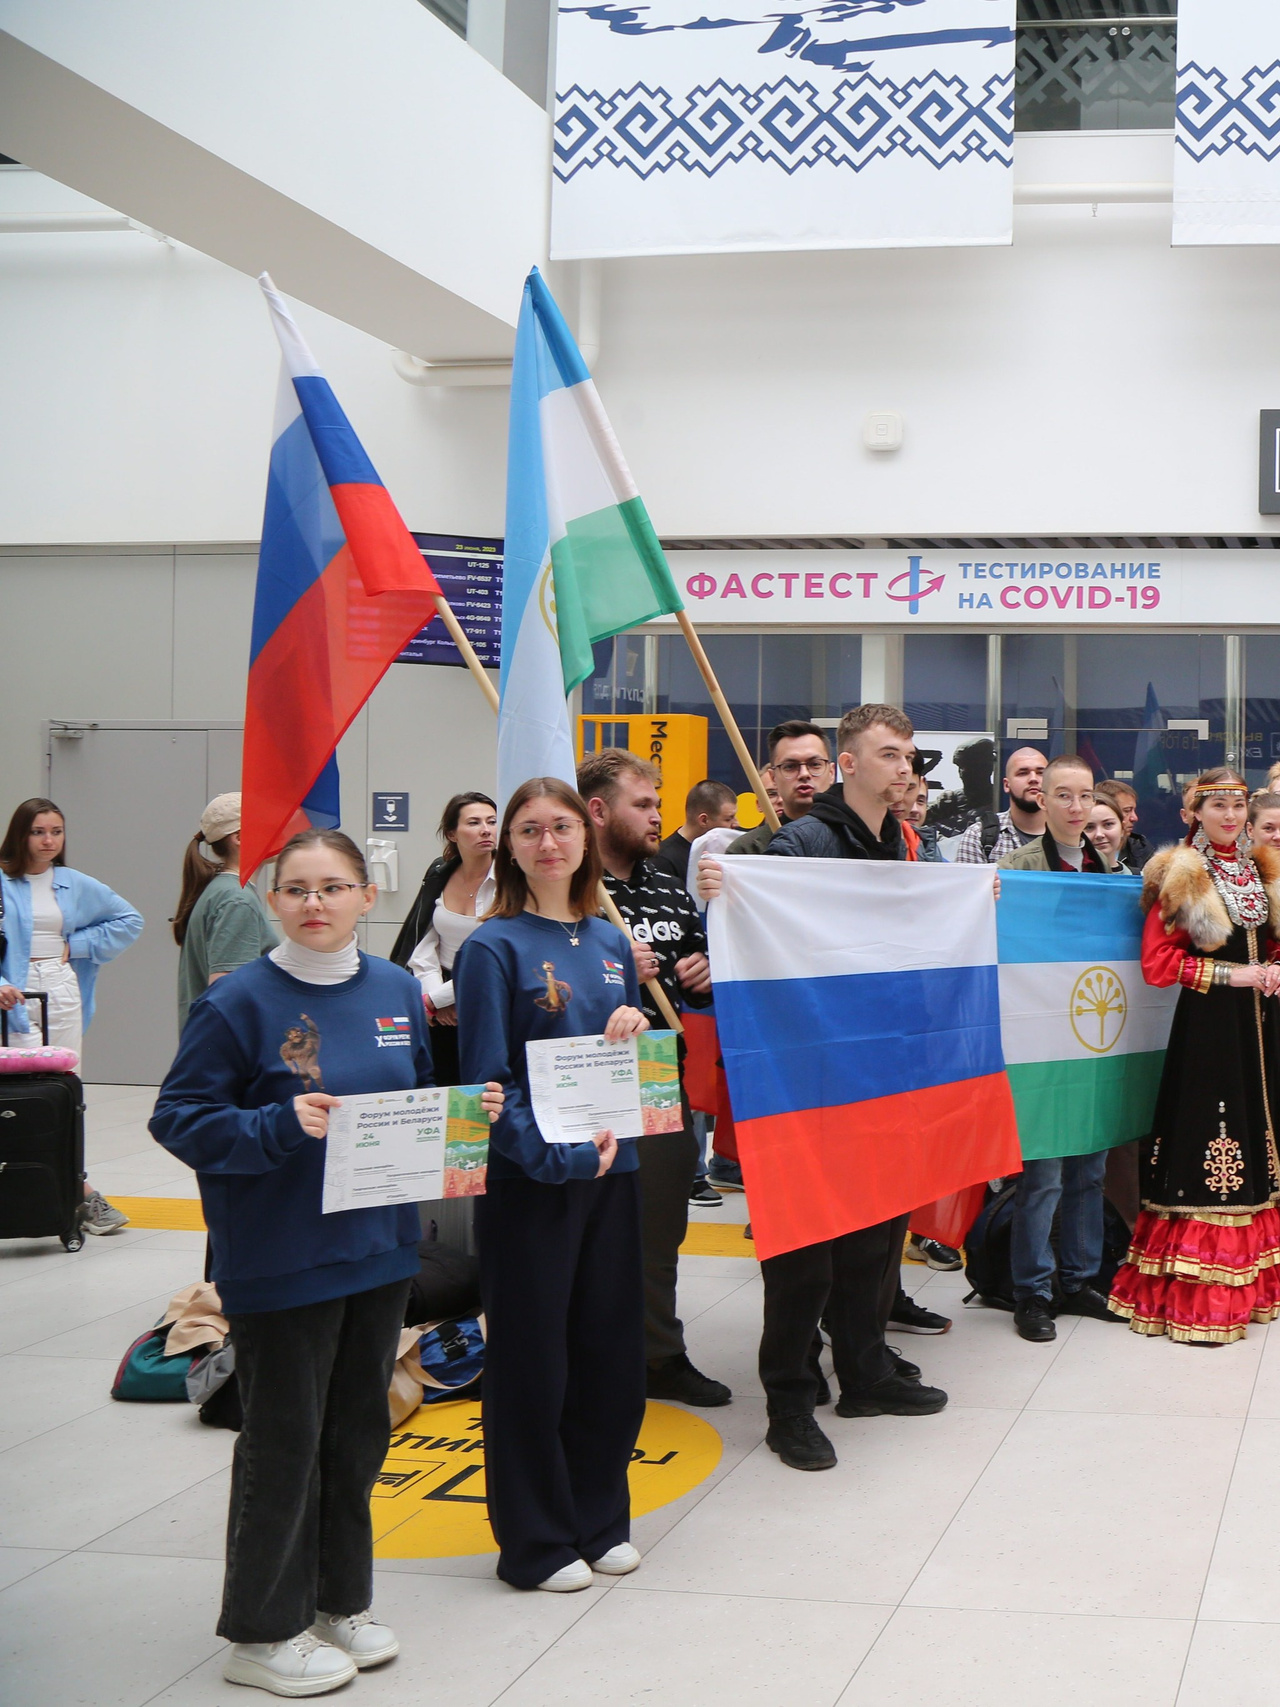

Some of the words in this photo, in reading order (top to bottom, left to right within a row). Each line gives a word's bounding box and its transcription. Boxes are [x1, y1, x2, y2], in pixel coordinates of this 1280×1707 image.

[959, 561, 1162, 581] ТЕСТИРОВАНИЕ
[686, 571, 879, 601] ФАСТЕСТ
[959, 592, 993, 609] НА
[1000, 585, 1162, 610] COVID-19
[623, 917, 682, 943] idas
[554, 1053, 584, 1063] Форум
[585, 1049, 630, 1059] молодёжи
[554, 1062, 584, 1071] России
[594, 1058, 634, 1068] Беларуси
[611, 1069, 633, 1077] УФА
[359, 1110, 391, 1120] Форум
[393, 1105, 439, 1116] молодёжи
[357, 1120, 390, 1130] России
[400, 1115, 443, 1126] Беларуси
[362, 1132, 374, 1140] 24
[417, 1126, 440, 1135] УФА
